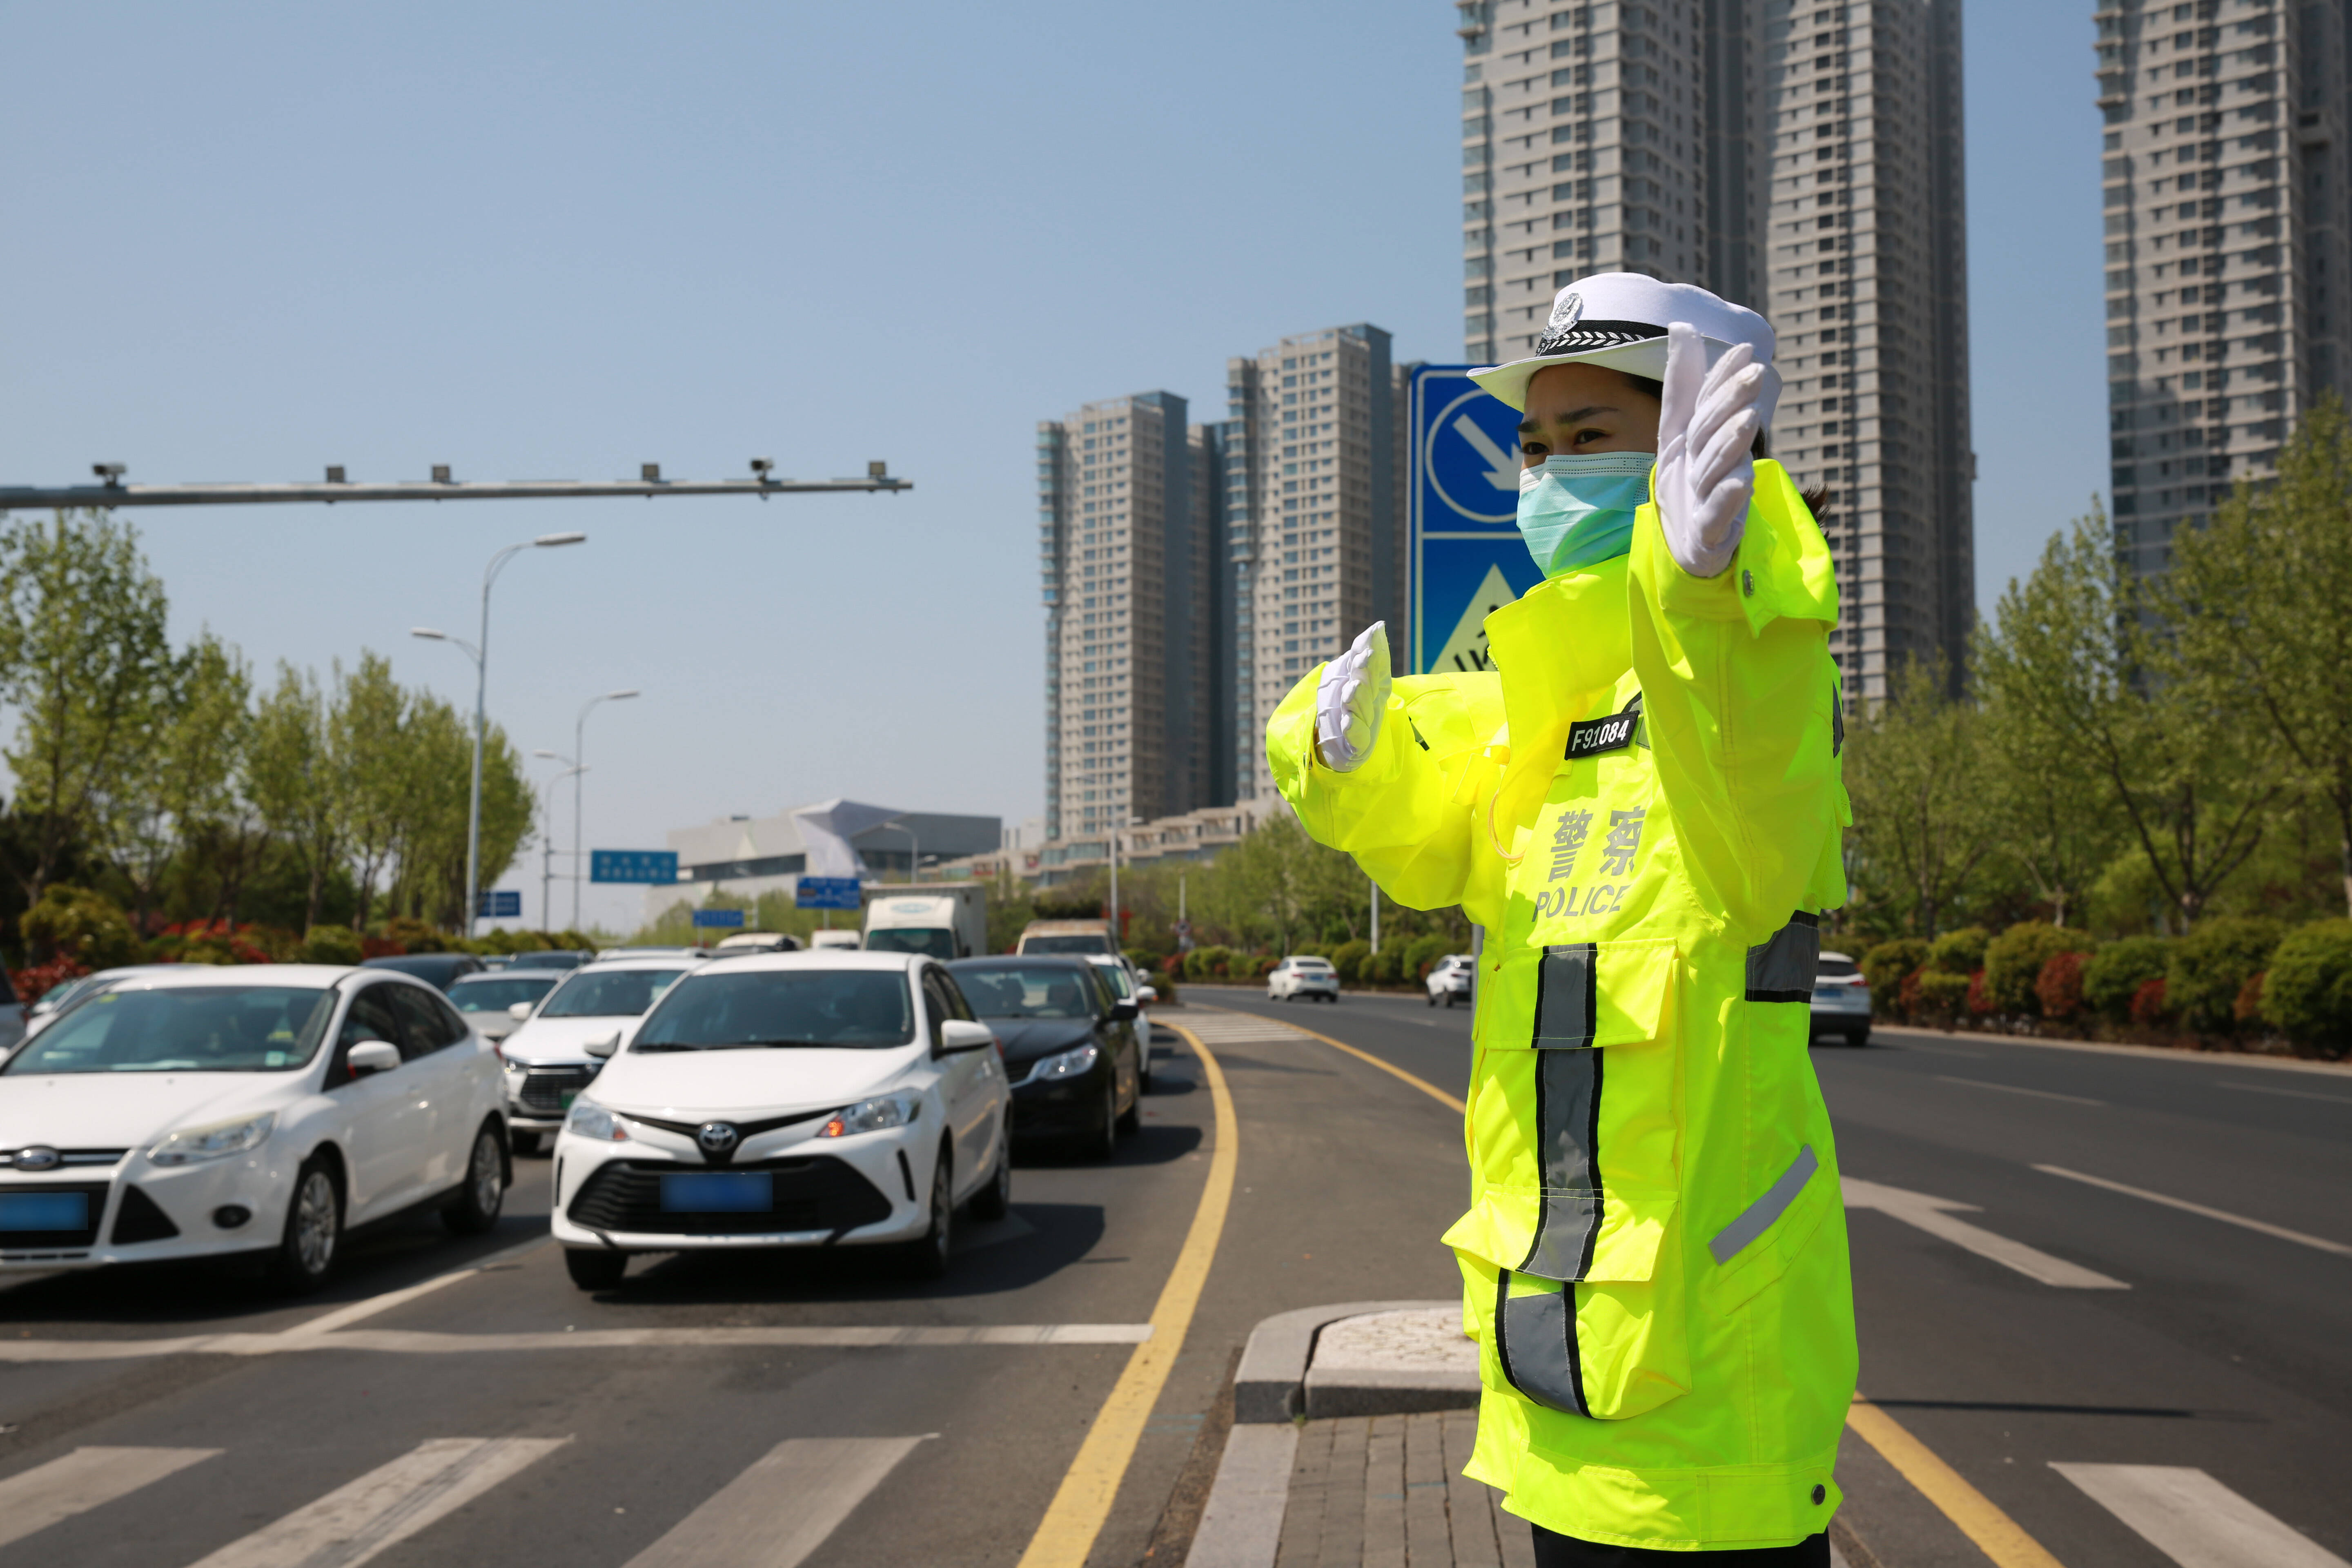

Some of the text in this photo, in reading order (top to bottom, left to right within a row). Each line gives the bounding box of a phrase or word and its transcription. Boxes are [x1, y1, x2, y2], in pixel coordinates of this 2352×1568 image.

[1571, 719, 1630, 751] F91084
[1548, 806, 1646, 882] 警察
[1532, 884, 1632, 922] POLICE
